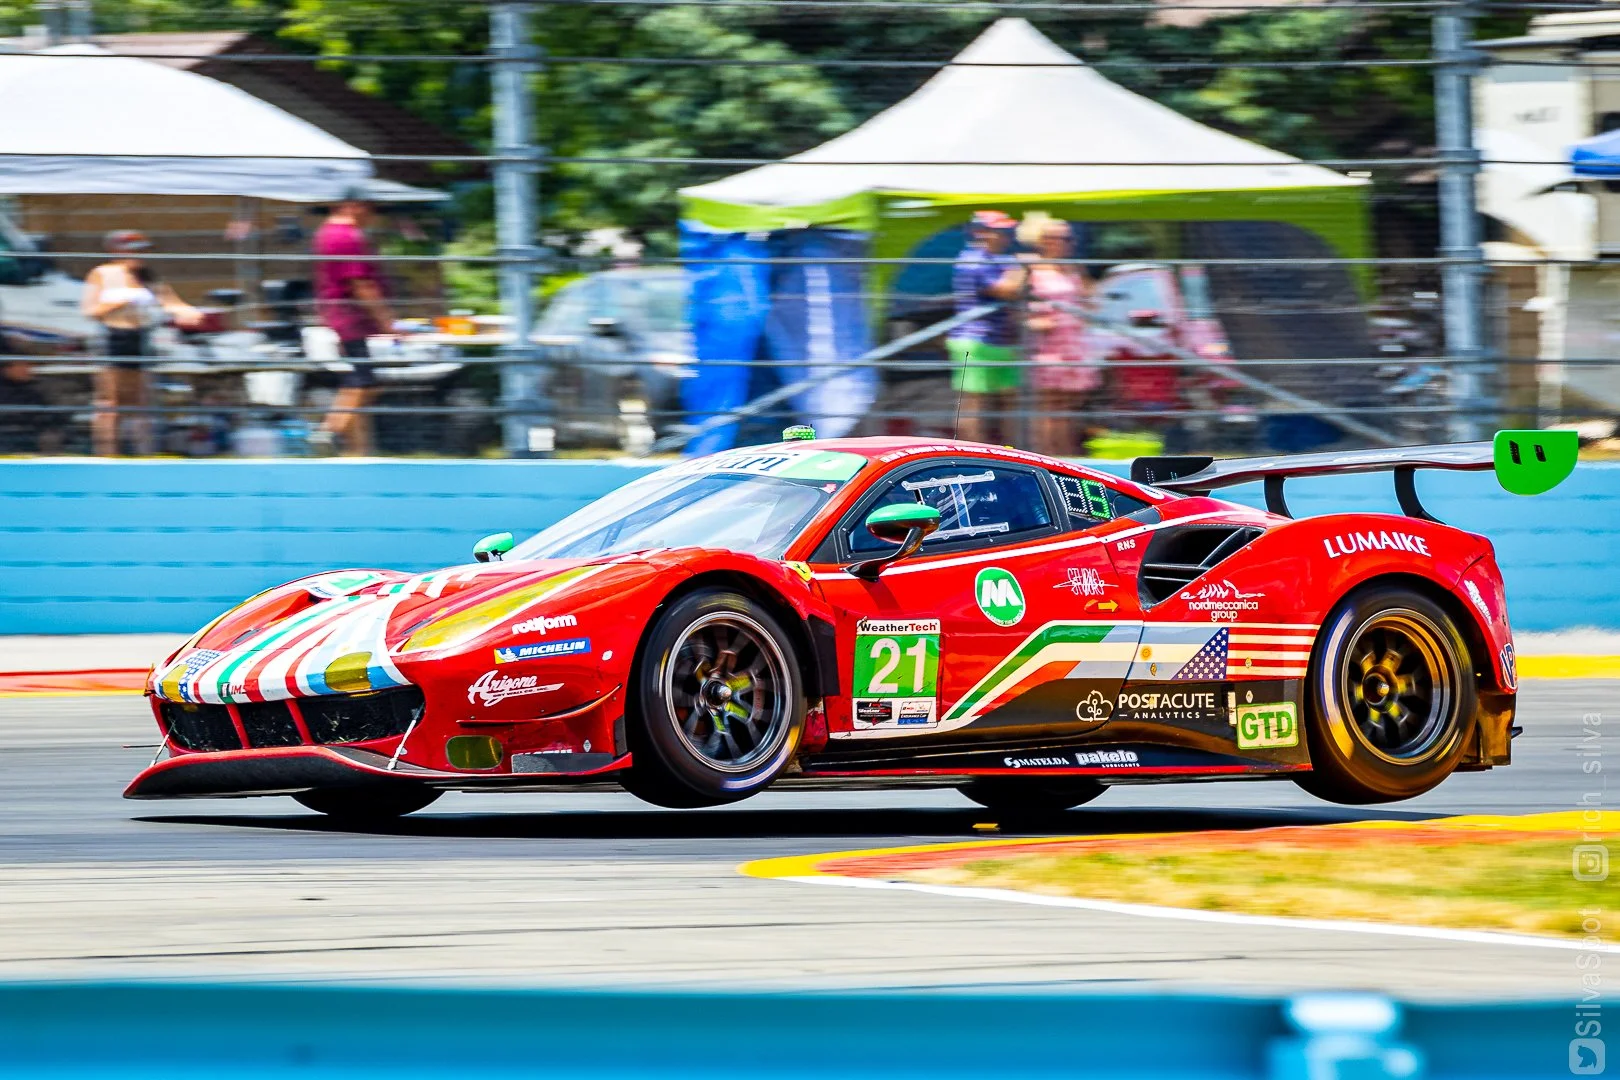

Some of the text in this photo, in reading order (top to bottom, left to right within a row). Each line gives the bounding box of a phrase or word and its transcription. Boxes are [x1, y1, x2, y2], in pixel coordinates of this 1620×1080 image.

[1116, 538, 1136, 551] RNS
[1323, 530, 1432, 558] LUMAIKE
[1188, 598, 1259, 610] nordmeccanica
[1210, 610, 1238, 622] group
[860, 622, 937, 632] WeatherTech
[519, 641, 586, 656] MICHELIN
[867, 637, 927, 694] 21
[1118, 693, 1215, 709] POSTACUTE
[1133, 711, 1201, 719] ANALYTICS
[1241, 711, 1293, 740] GTD
[1075, 750, 1139, 766] pakelo
